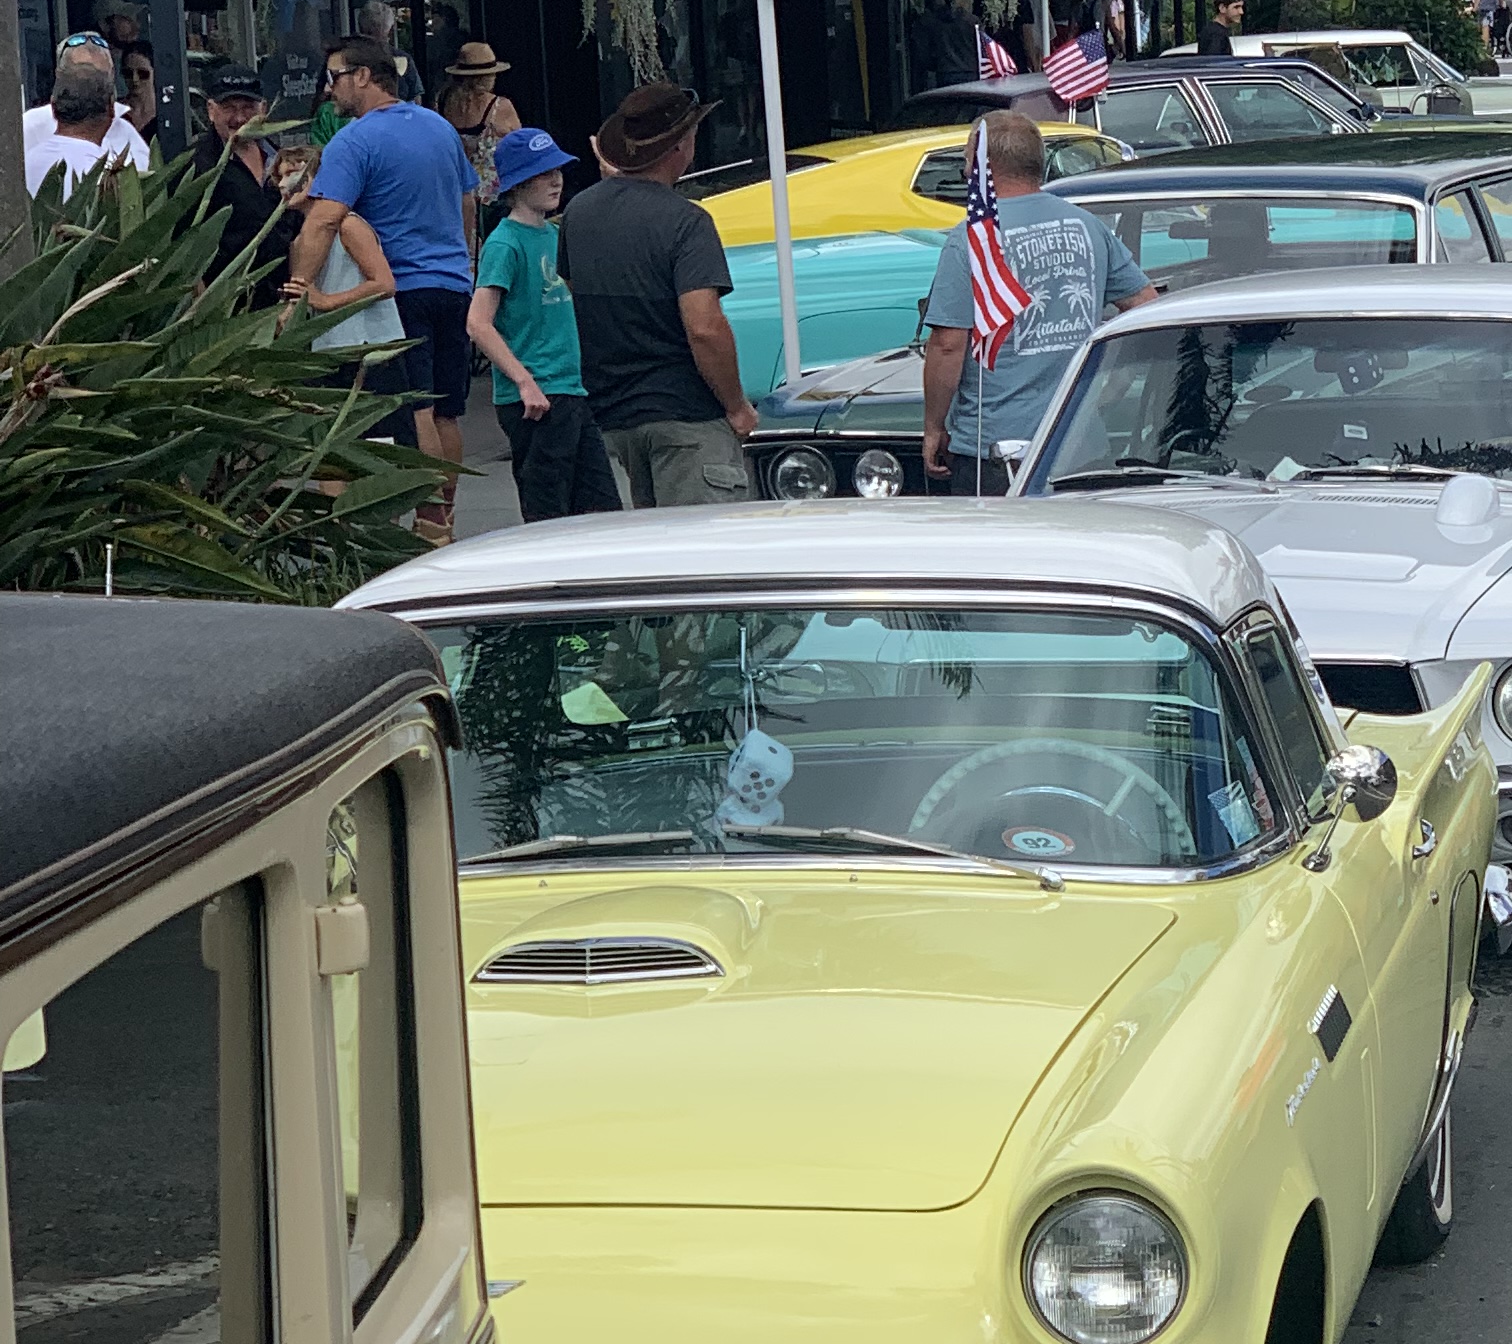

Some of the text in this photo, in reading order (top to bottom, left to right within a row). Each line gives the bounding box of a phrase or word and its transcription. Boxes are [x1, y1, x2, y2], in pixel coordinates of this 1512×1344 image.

[1016, 231, 1087, 270] STONEFISH
[1033, 252, 1075, 270] STUDIO
[1027, 316, 1086, 339] Aitutaki
[1022, 837, 1057, 849] 92
